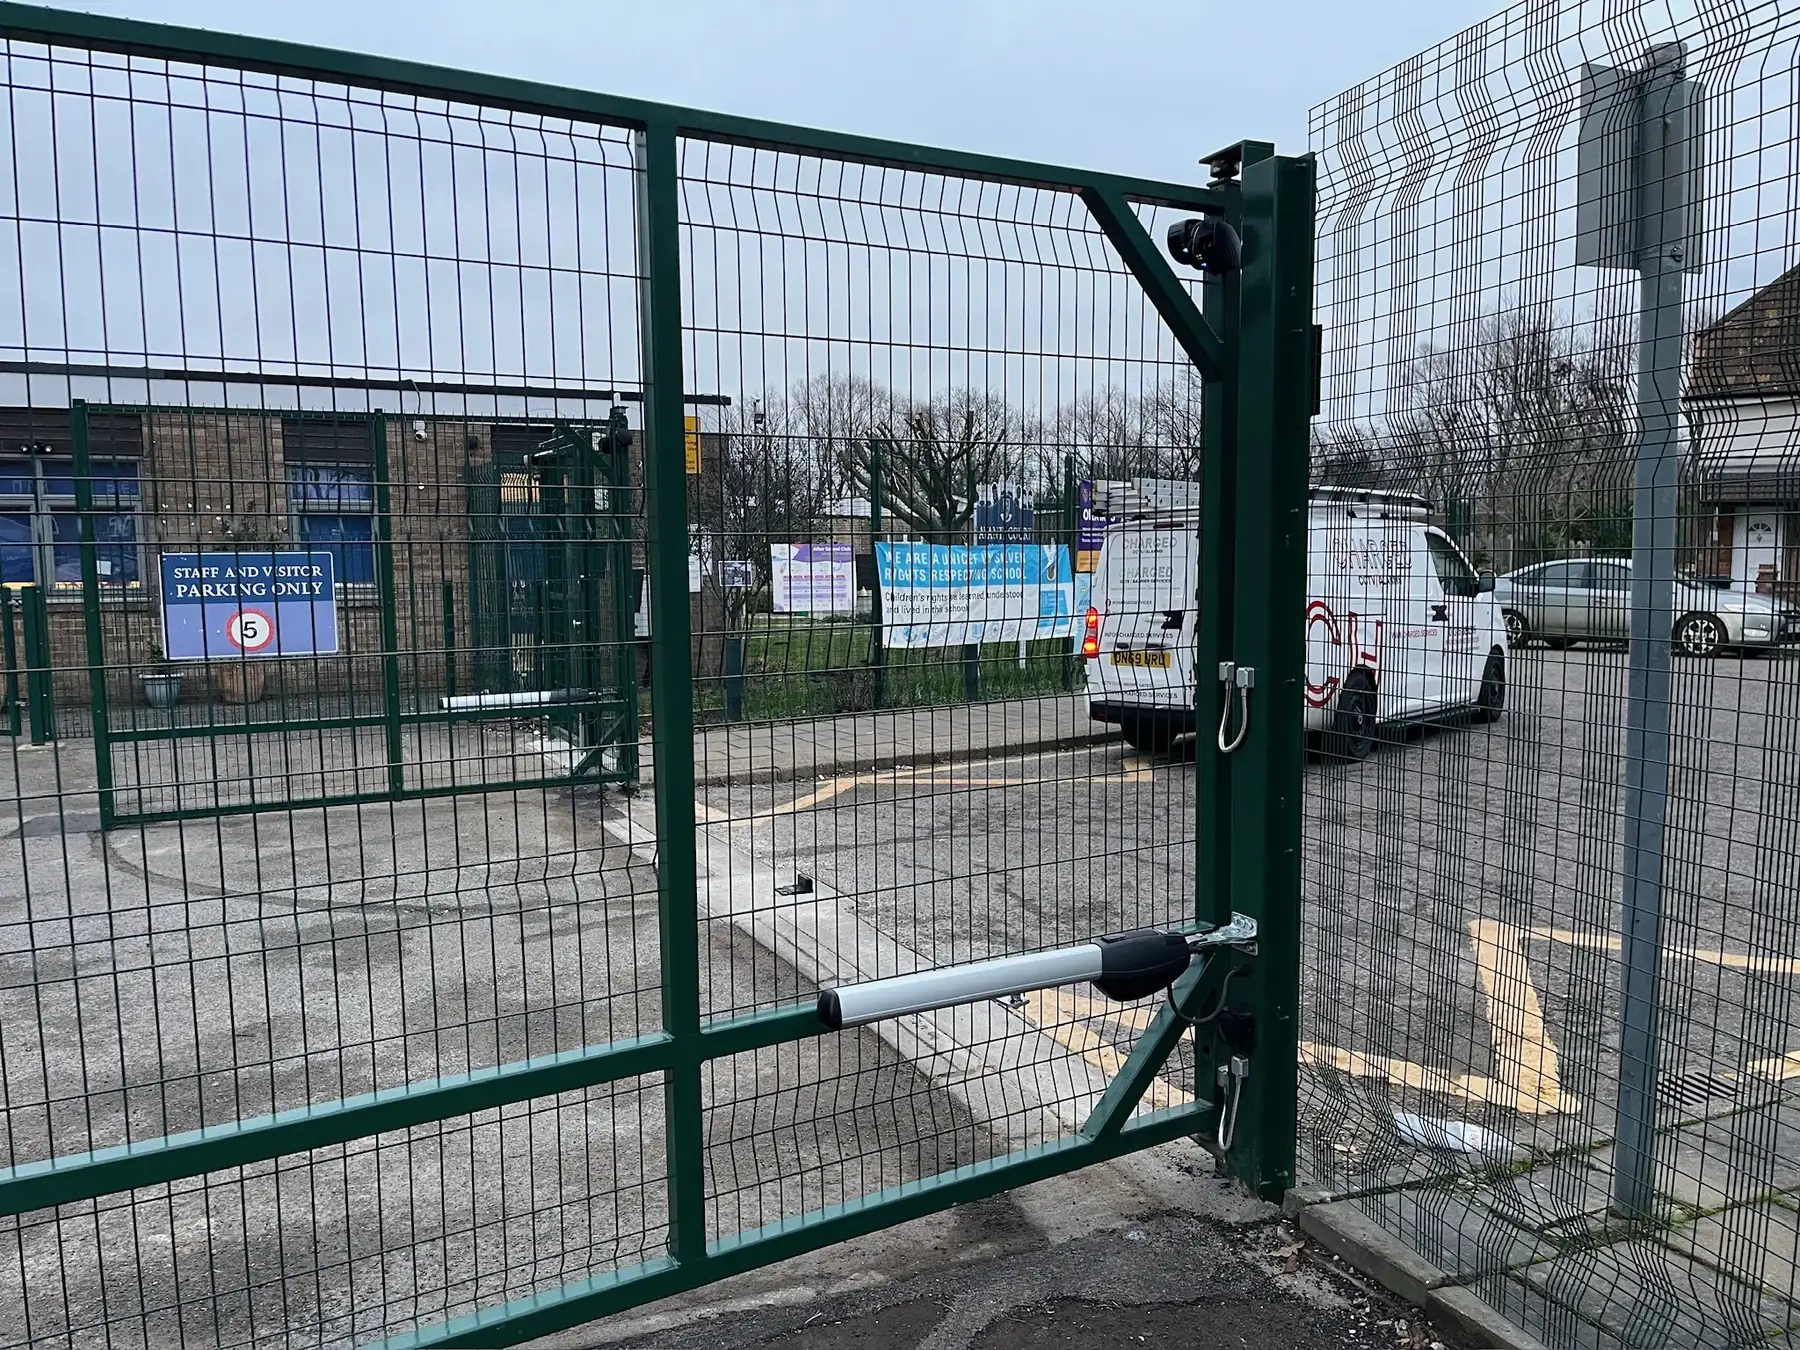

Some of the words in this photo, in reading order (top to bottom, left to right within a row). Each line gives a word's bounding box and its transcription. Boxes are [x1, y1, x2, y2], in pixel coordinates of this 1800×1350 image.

[1124, 537, 1178, 549] CHARGED
[905, 552, 928, 565] ARE
[932, 552, 940, 565] A
[174, 567, 219, 579] STAFF
[225, 566, 259, 578] AND
[262, 565, 323, 577] VSITOR
[884, 568, 926, 581] RIGHTS
[932, 568, 987, 581] RESPECTING
[176, 583, 267, 597] PARKING
[272, 582, 323, 596] ONLY
[885, 591, 925, 601] Cildren's
[926, 592, 948, 603] rghts
[987, 591, 1023, 600] undestood
[945, 604, 969, 613] shool
[241, 621, 257, 638] 5
